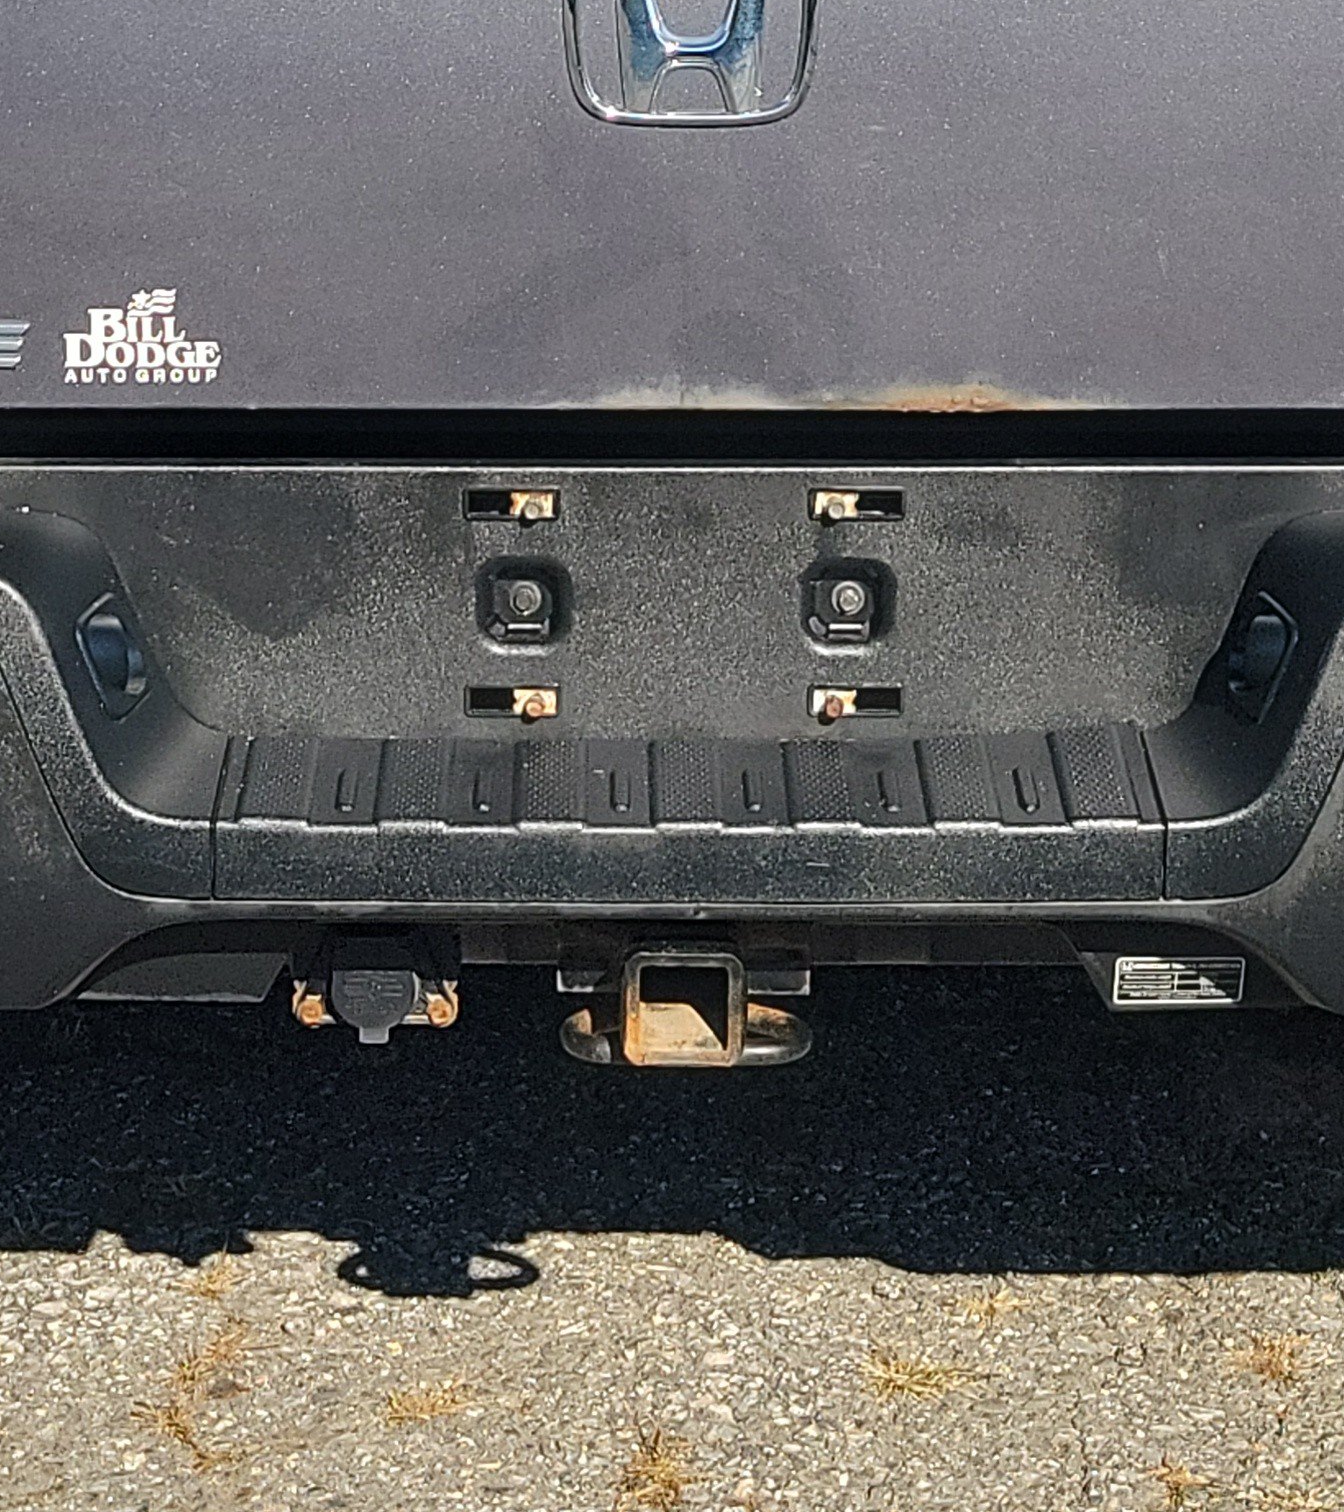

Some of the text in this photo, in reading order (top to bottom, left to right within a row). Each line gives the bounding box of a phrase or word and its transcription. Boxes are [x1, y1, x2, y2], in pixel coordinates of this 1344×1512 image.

[87, 308, 186, 343] BILL
[62, 332, 222, 368] DODGE
[64, 368, 219, 384] AUTO GROUP
